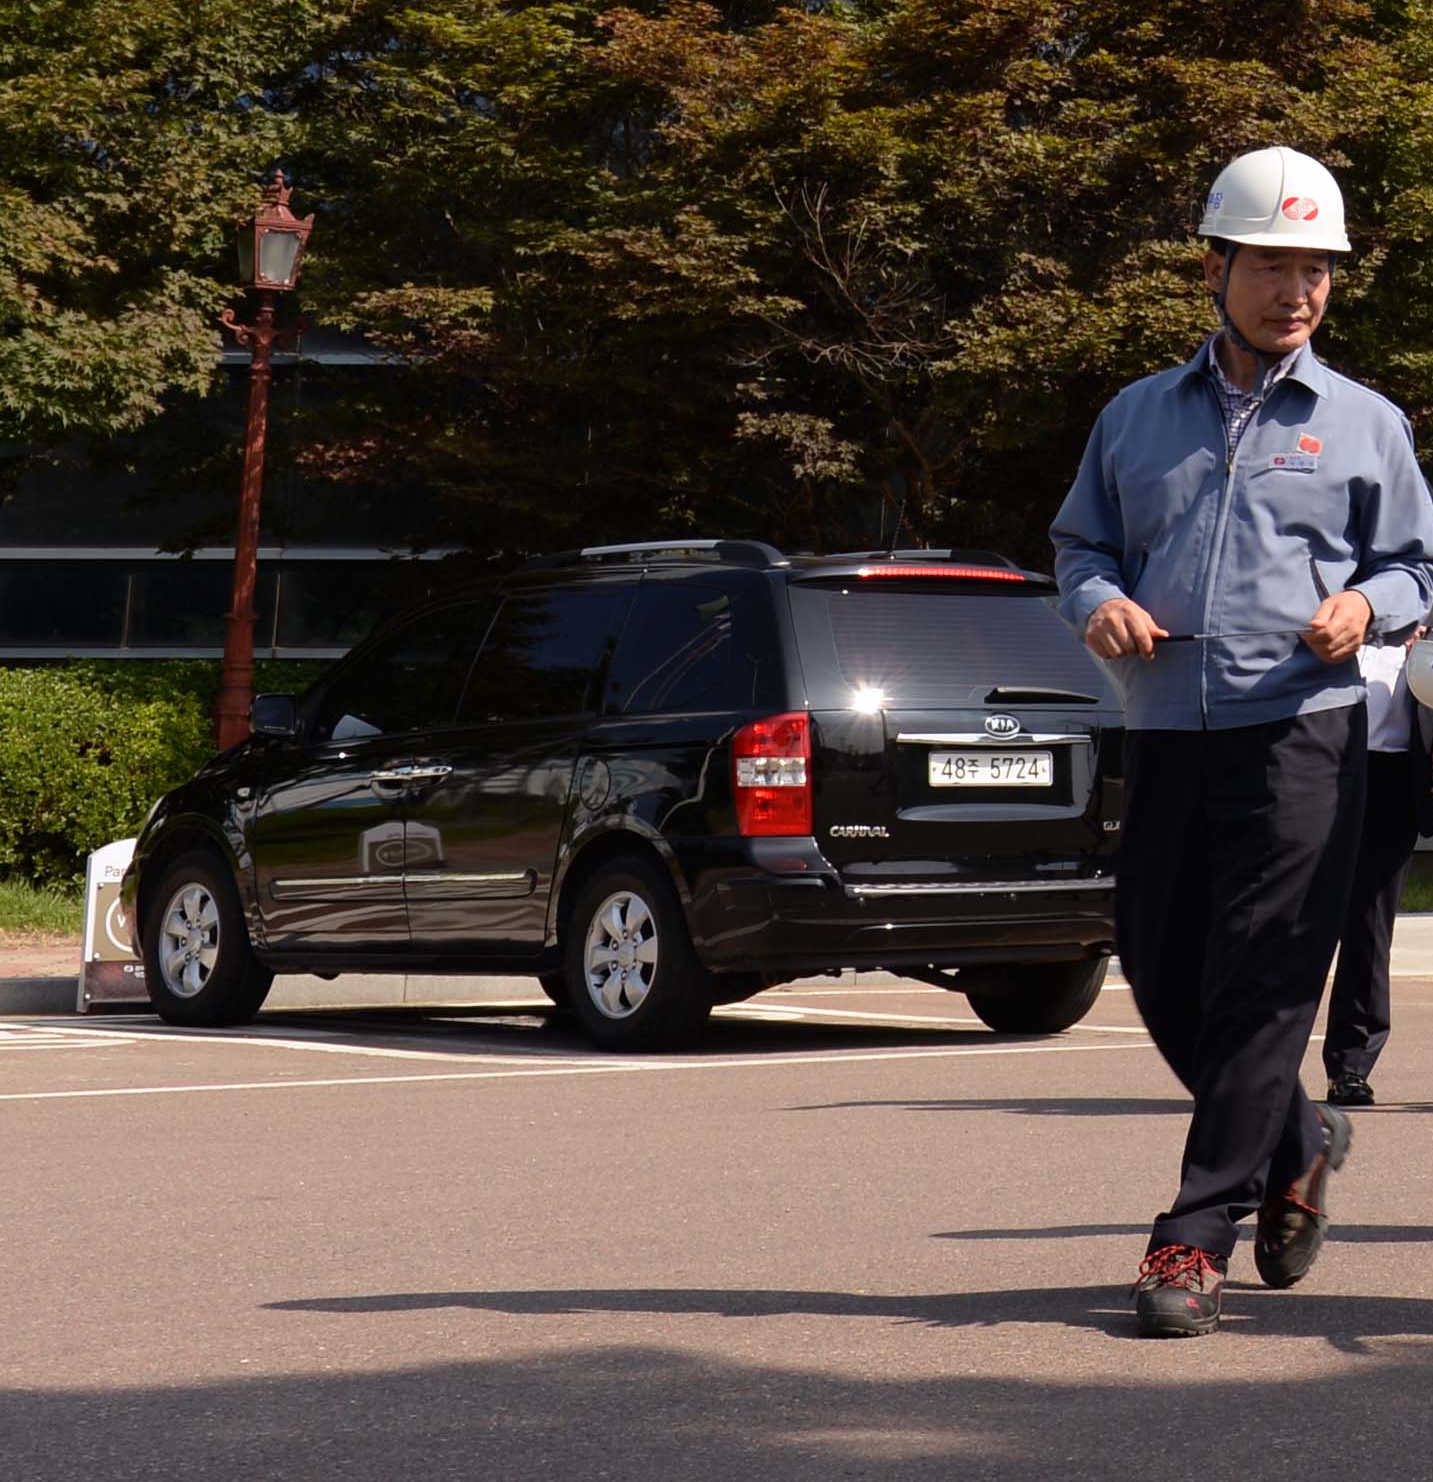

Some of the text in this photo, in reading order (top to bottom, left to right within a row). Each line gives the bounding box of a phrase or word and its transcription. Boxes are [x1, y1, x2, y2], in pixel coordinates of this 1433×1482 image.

[991, 718, 1015, 731] KIA
[941, 758, 1040, 779] 48주 5724
